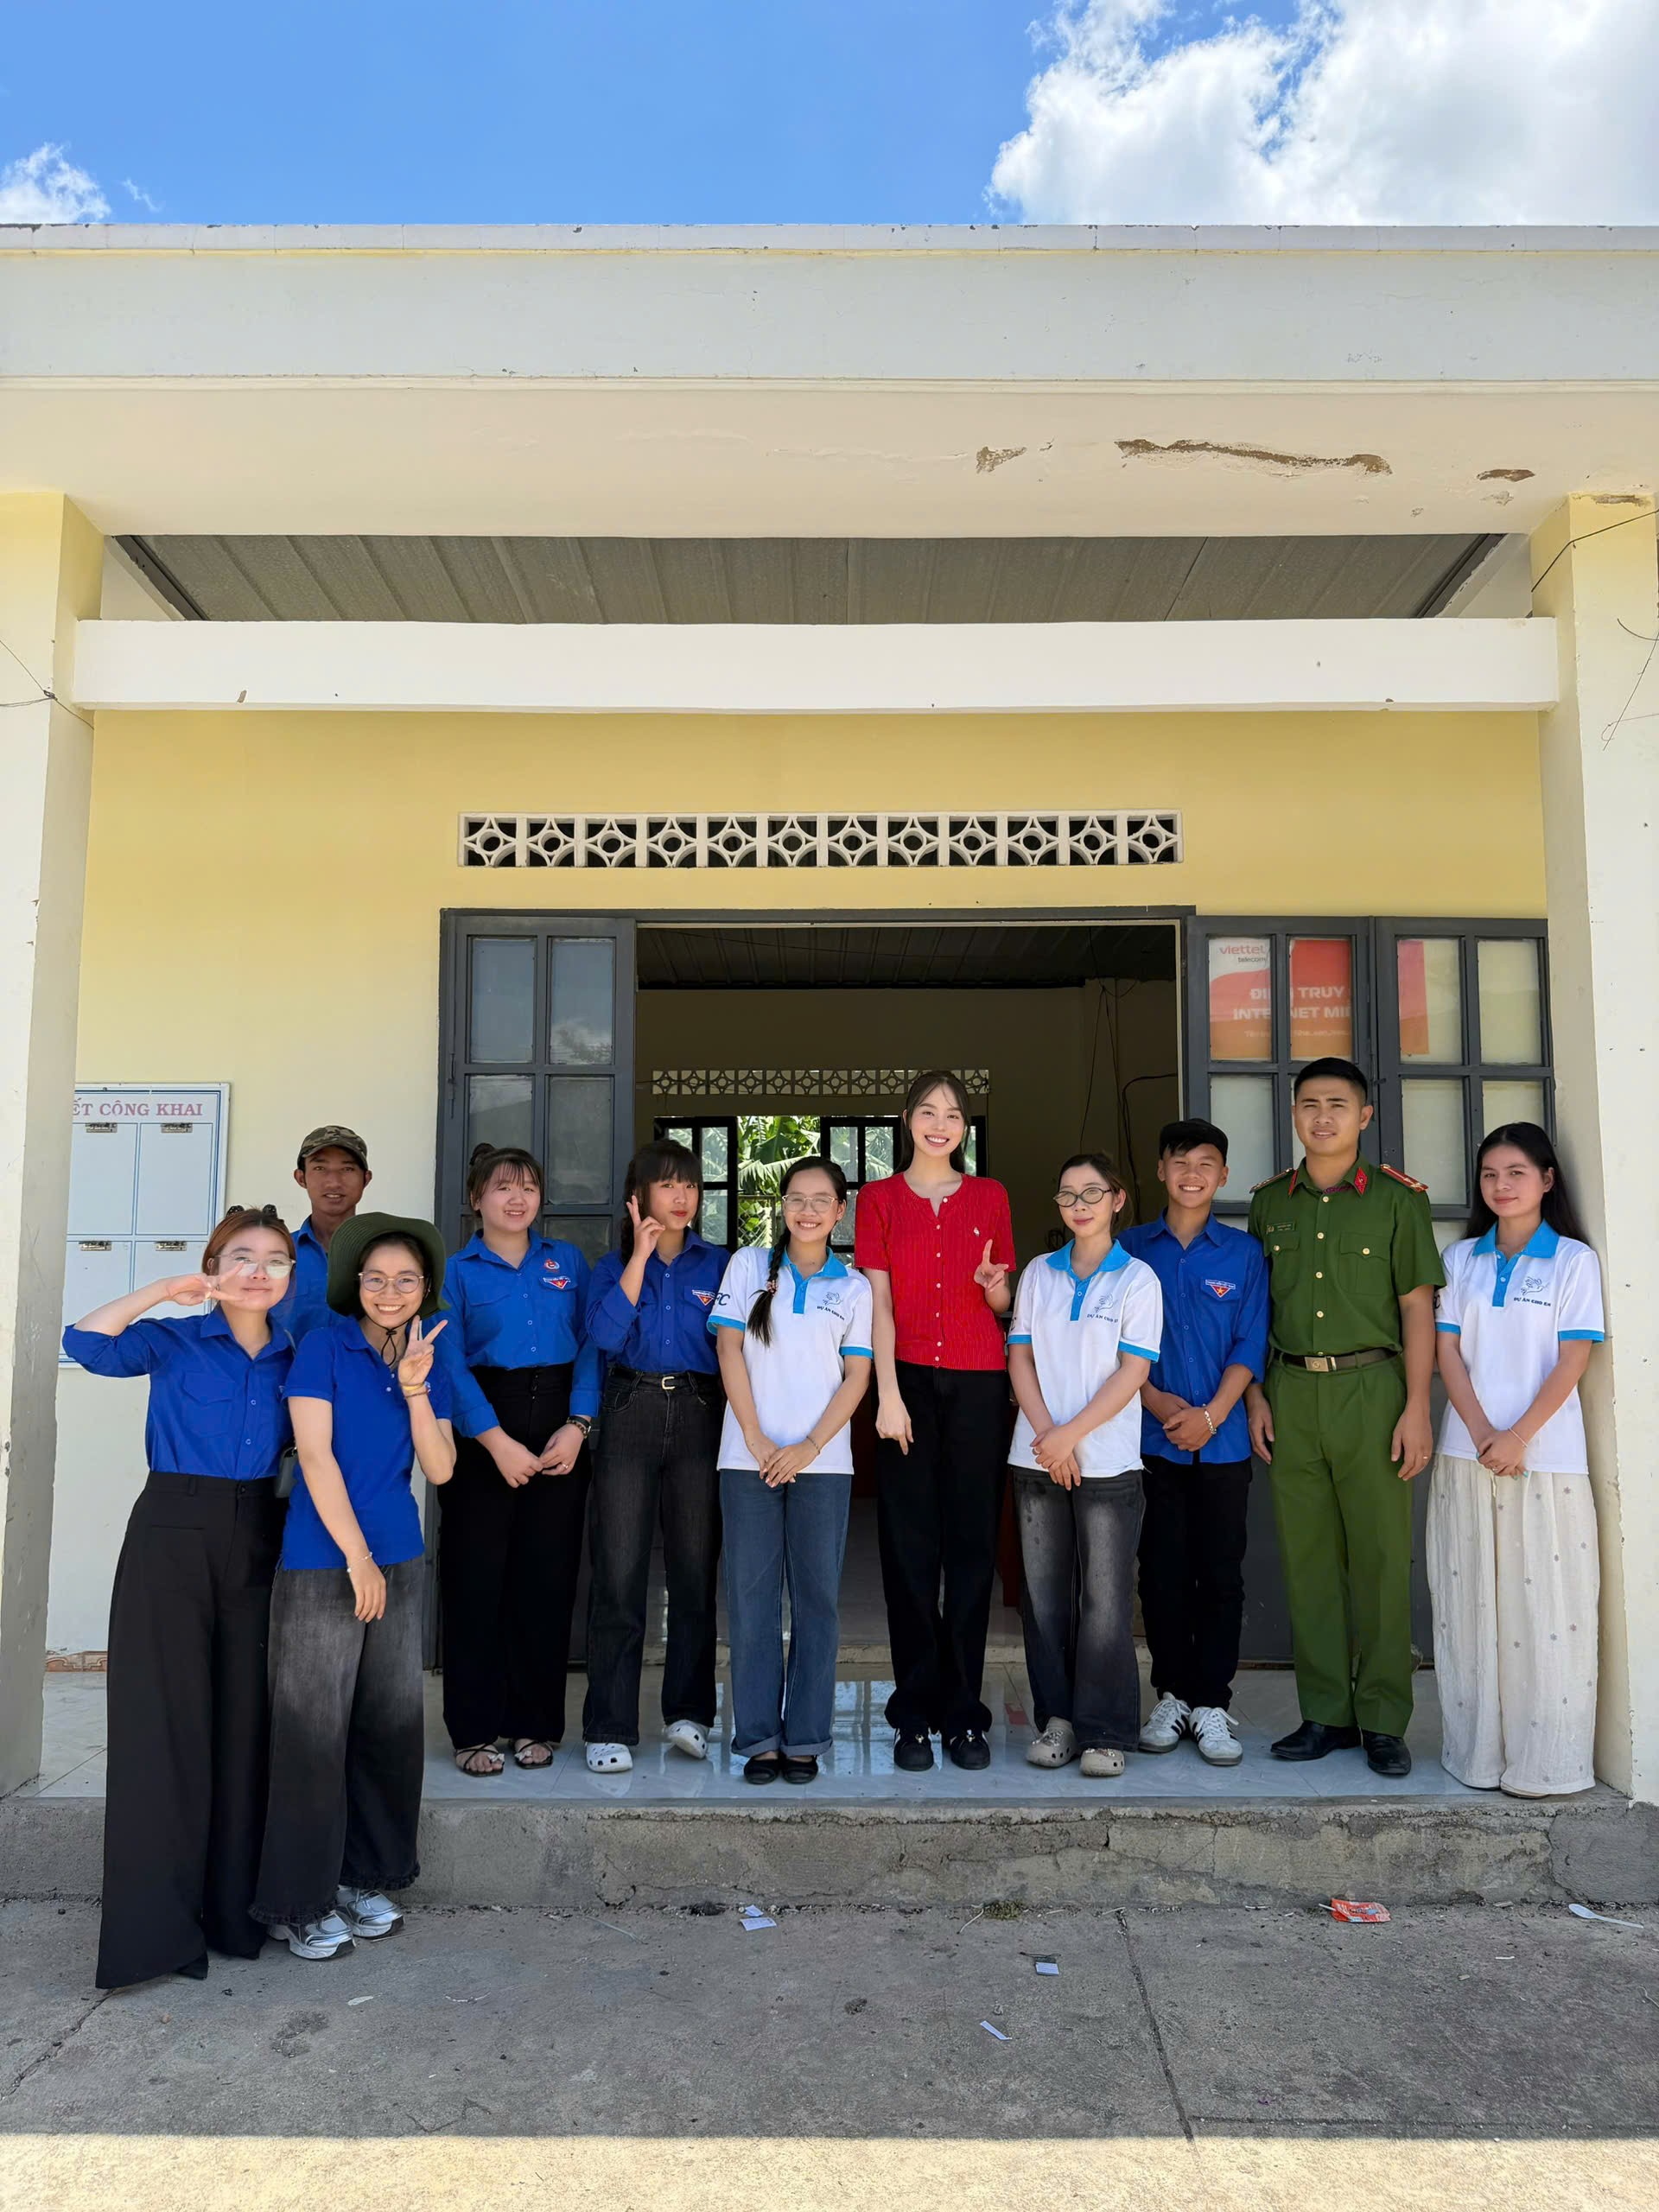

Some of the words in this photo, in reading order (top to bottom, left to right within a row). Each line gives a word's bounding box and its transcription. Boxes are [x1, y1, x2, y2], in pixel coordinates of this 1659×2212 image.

[1219, 944, 1266, 955] viettel
[1298, 986, 1345, 999] TRUY
[1233, 1006, 1321, 1020] INTENET
[99, 1099, 150, 1116] CÔNG
[156, 1103, 203, 1116] KHAI
